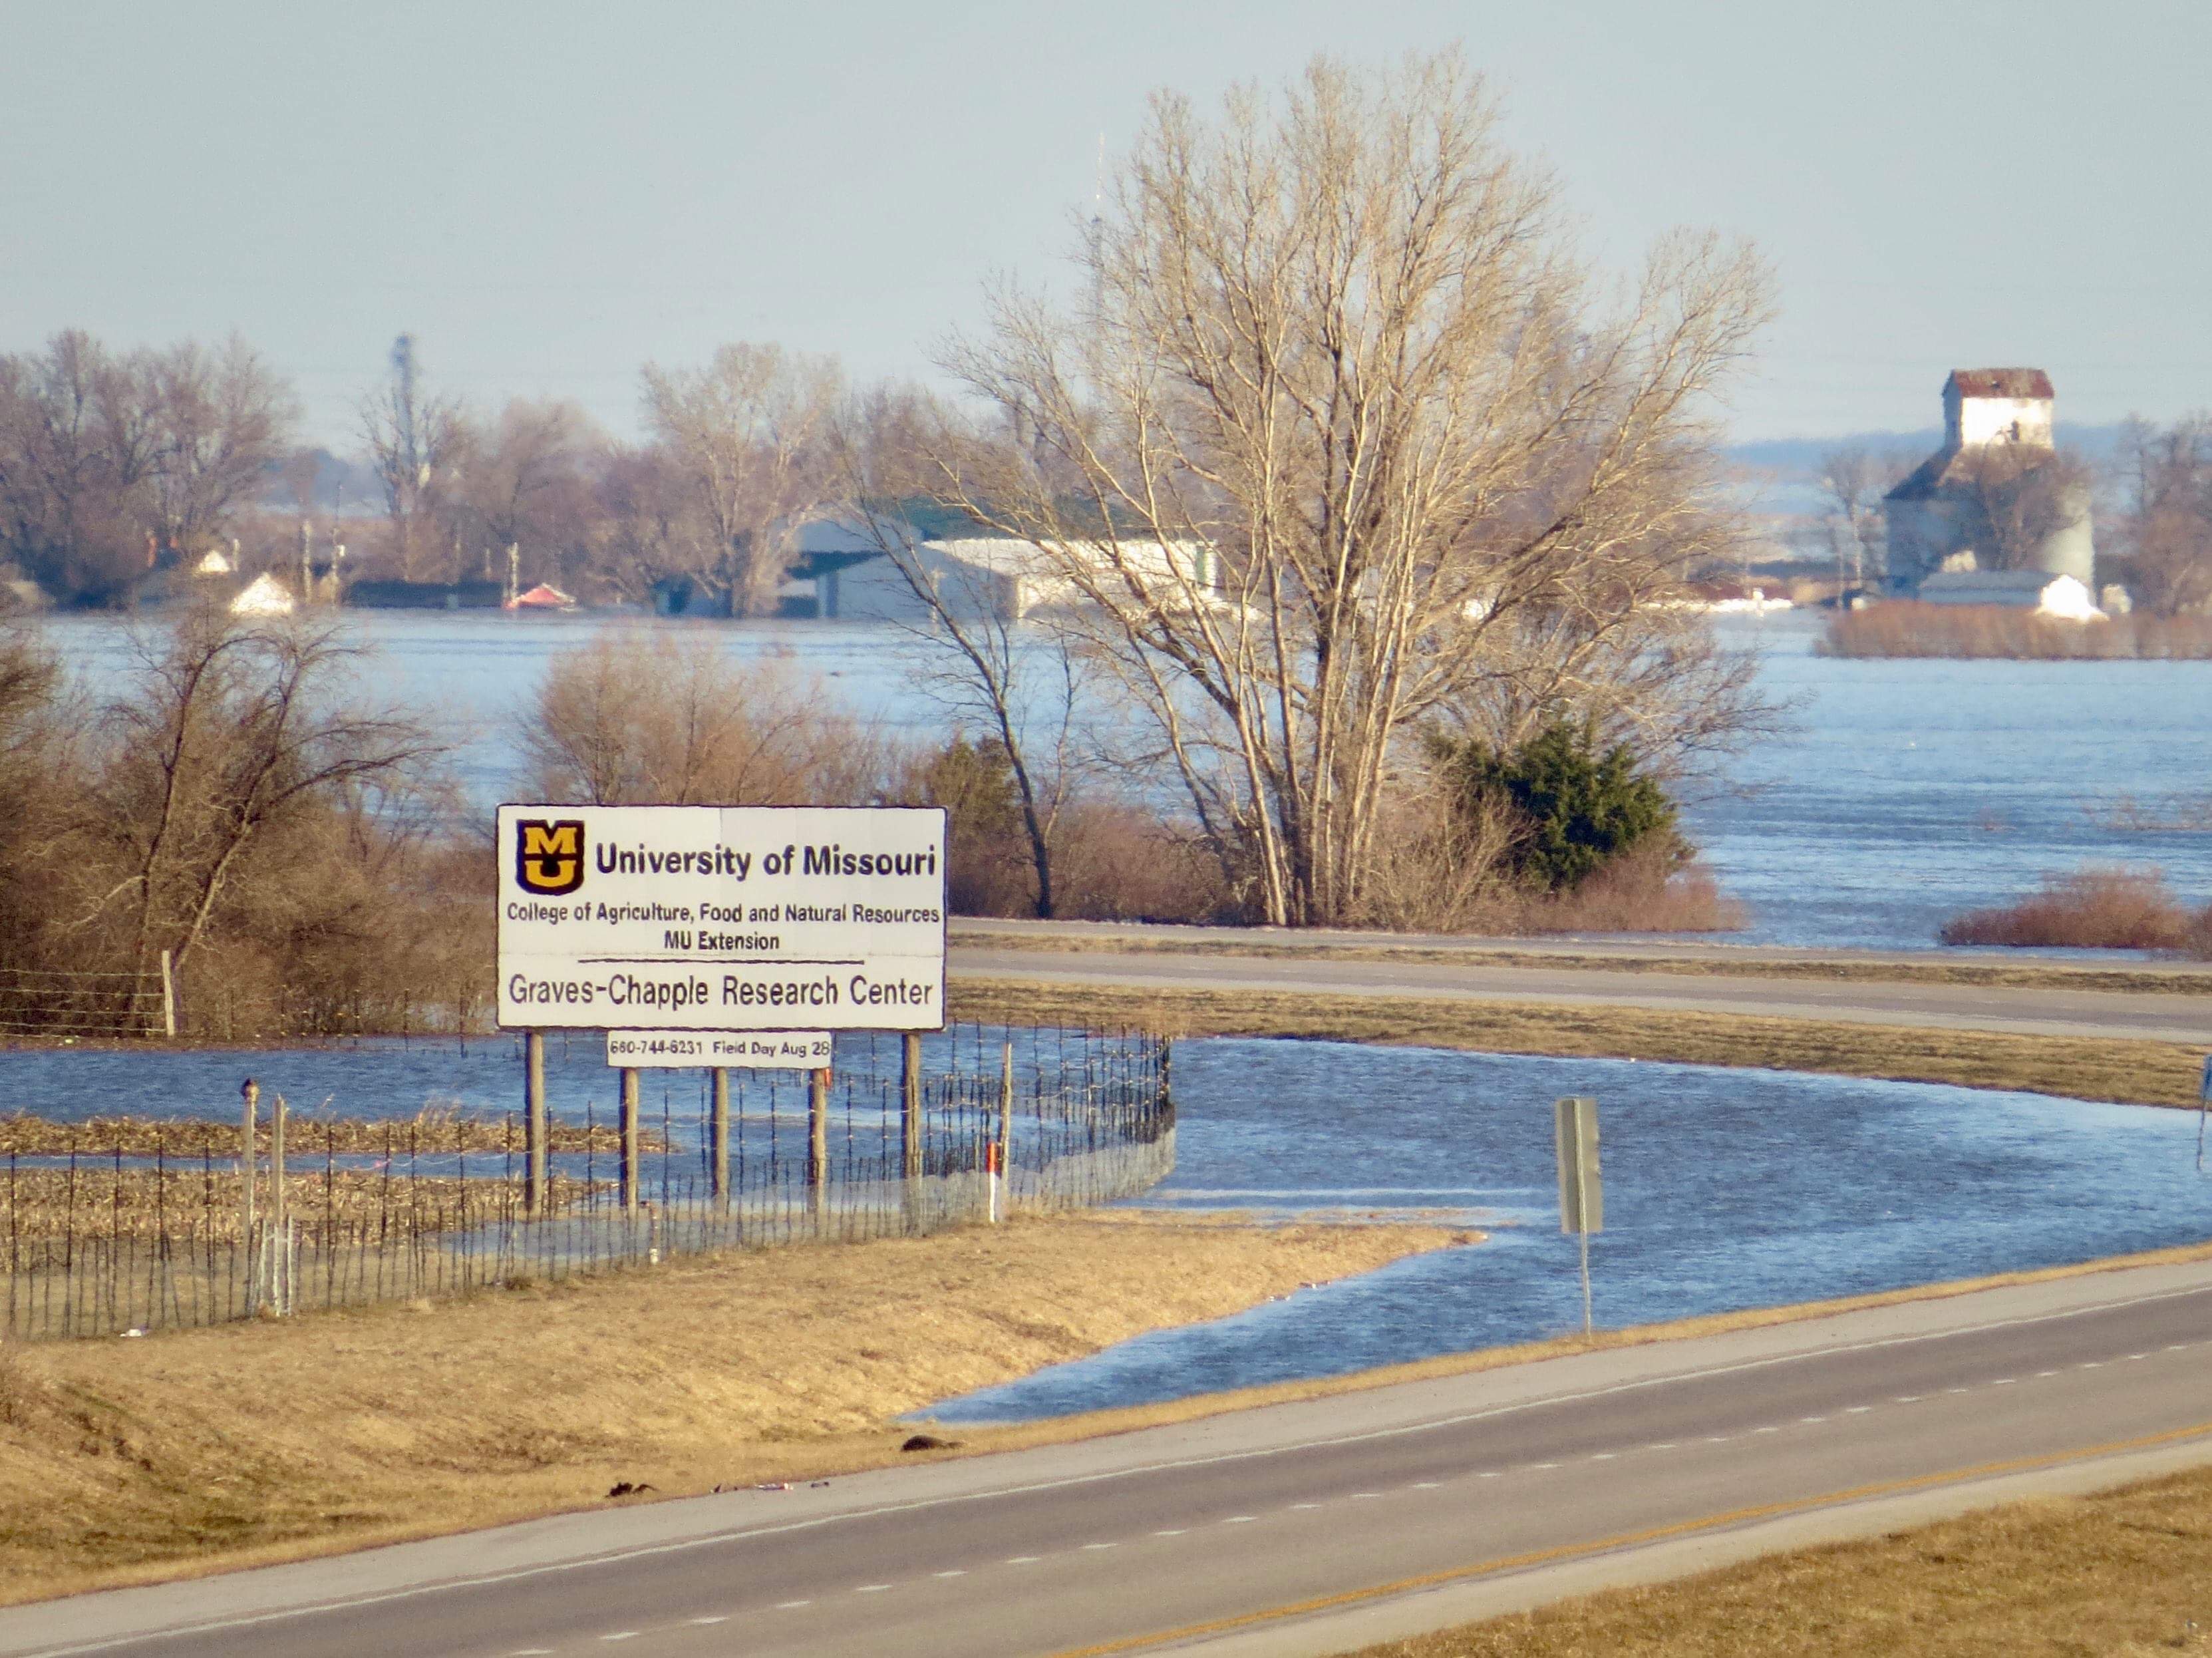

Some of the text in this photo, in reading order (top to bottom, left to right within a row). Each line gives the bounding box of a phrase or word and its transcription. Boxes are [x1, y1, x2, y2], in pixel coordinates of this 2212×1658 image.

[597, 842, 935, 882] University of Missouri
[508, 902, 939, 925] College of Agriculture, Food and Natural Resources
[665, 930, 779, 950] MU Extension
[509, 974, 932, 1011] Graves-Chapple Research Center
[713, 1041, 745, 1054] Field
[751, 1042, 776, 1057] Day
[781, 1042, 806, 1058] Aug
[812, 1041, 830, 1055] 28
